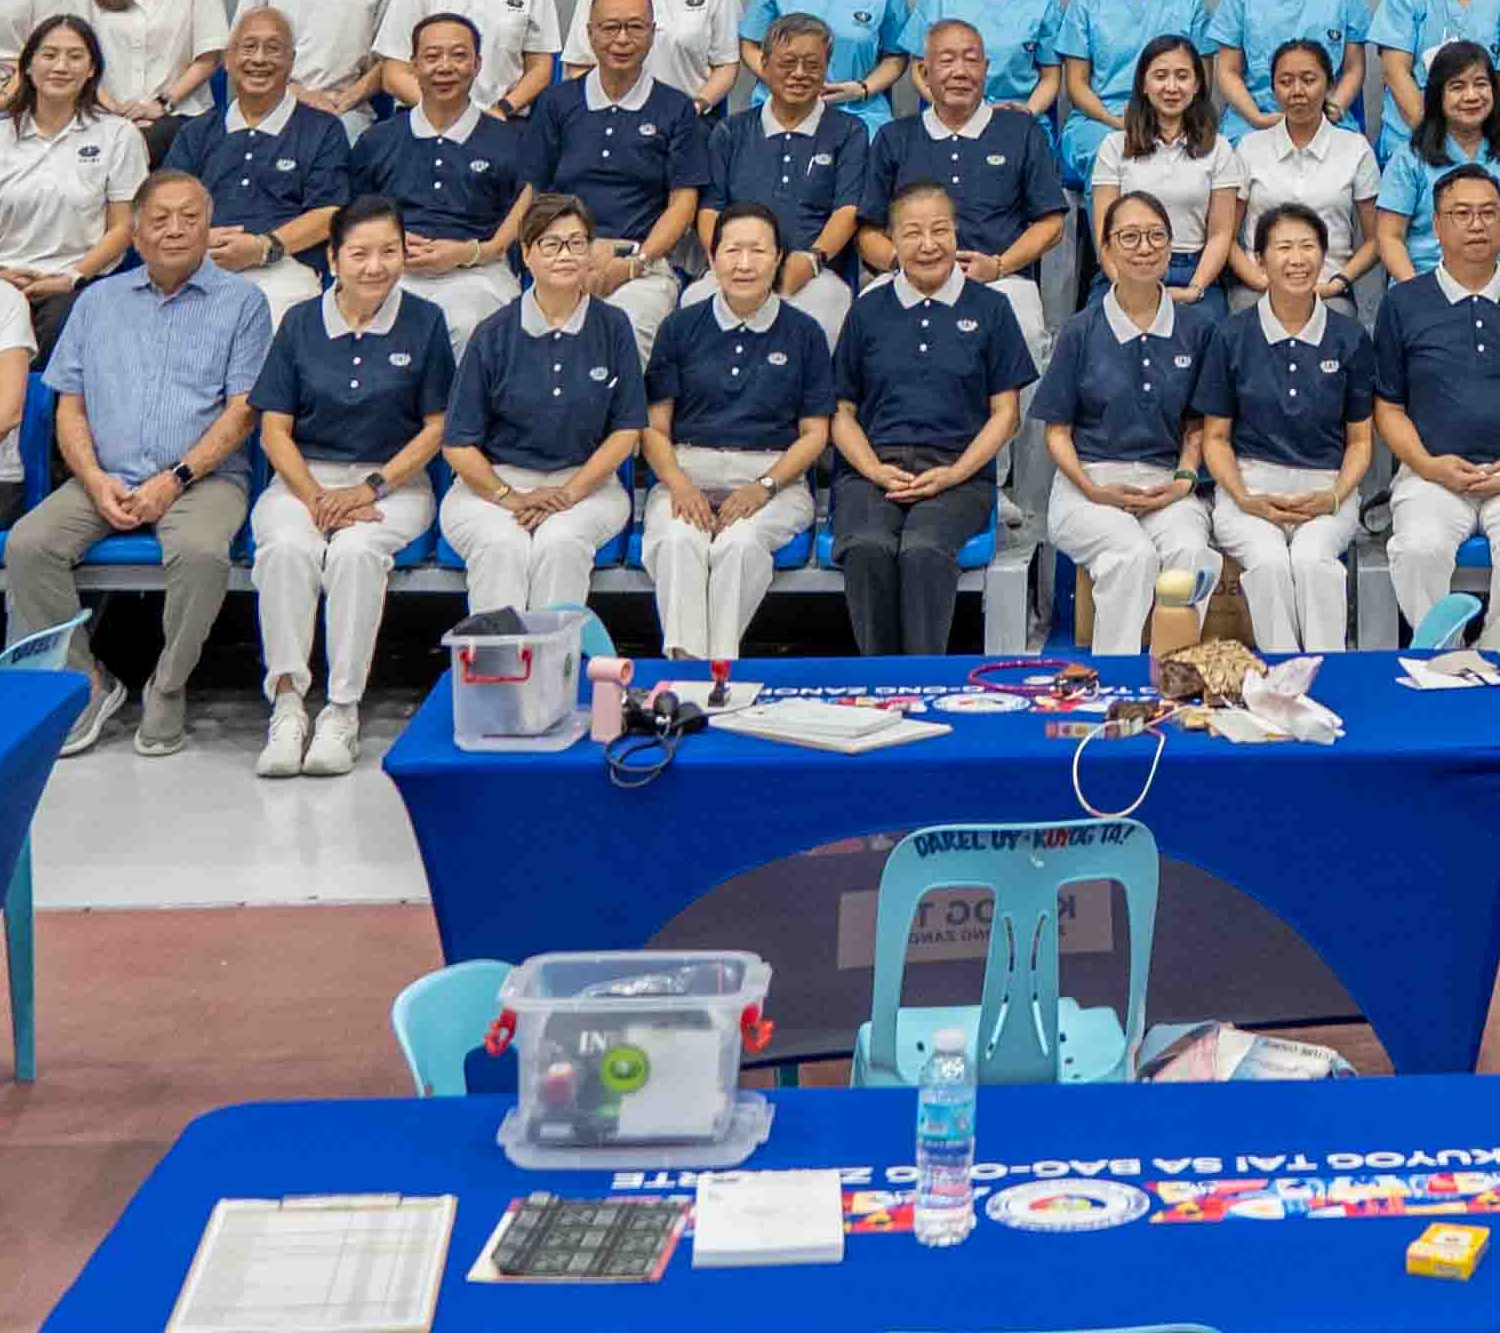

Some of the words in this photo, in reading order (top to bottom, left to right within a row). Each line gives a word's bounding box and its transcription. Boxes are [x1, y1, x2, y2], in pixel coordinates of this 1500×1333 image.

[913, 830, 986, 857] DAREL
[1100, 823, 1136, 846] TA!
[884, 1158, 1141, 1183] BAG-OG
[1152, 1155, 1223, 1174] SA
